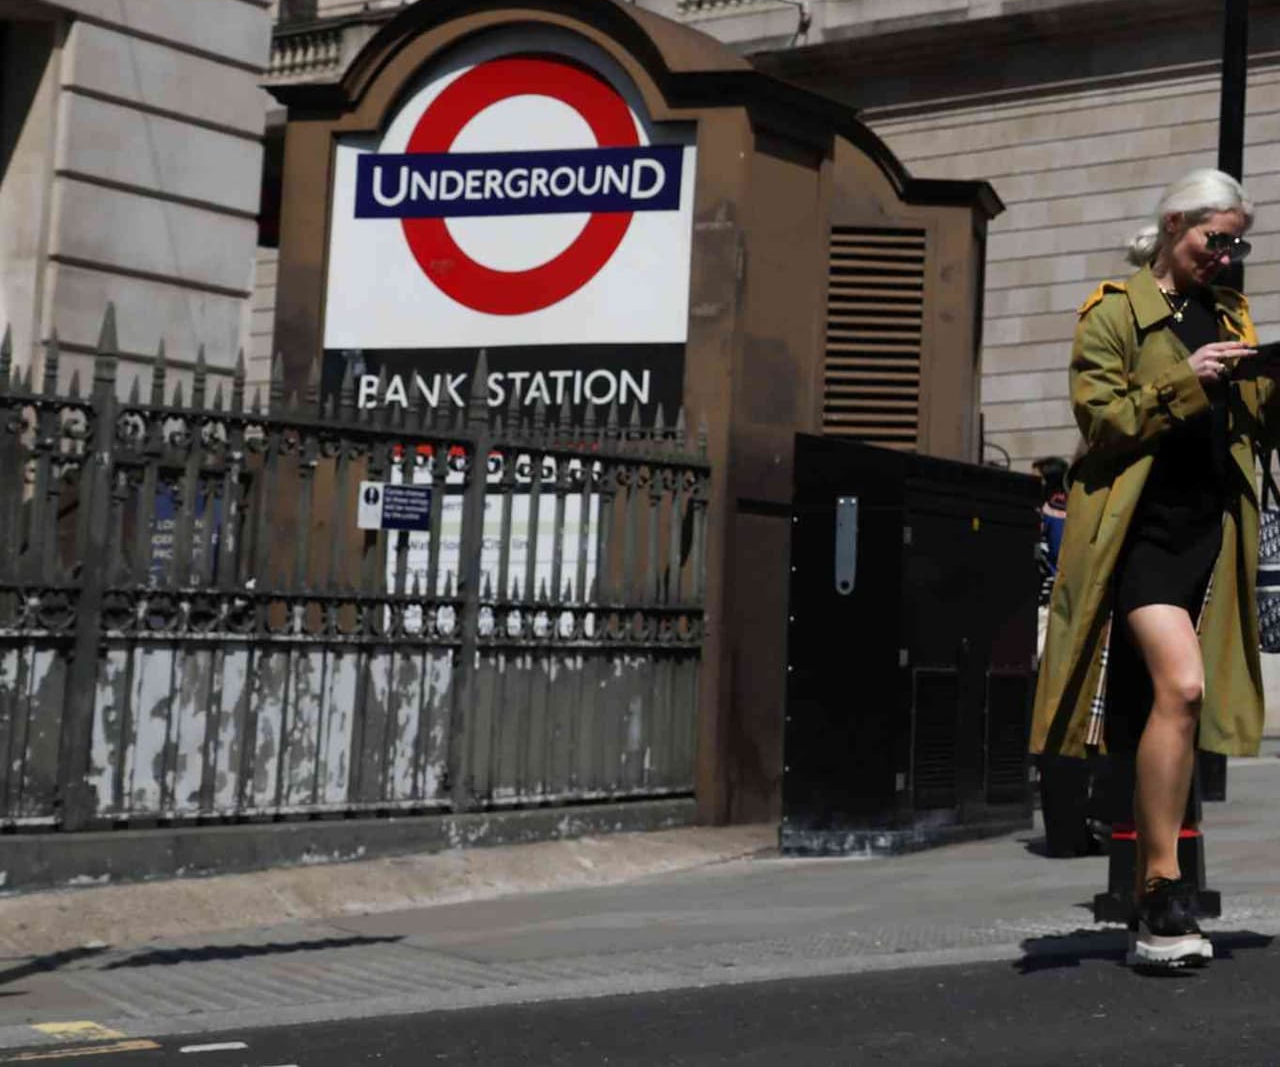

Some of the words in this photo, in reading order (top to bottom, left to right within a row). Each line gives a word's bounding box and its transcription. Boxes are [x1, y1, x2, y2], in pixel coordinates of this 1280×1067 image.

[373, 158, 666, 207] UNDERGROUND
[358, 373, 468, 409] BANK
[486, 369, 651, 407] STATION
